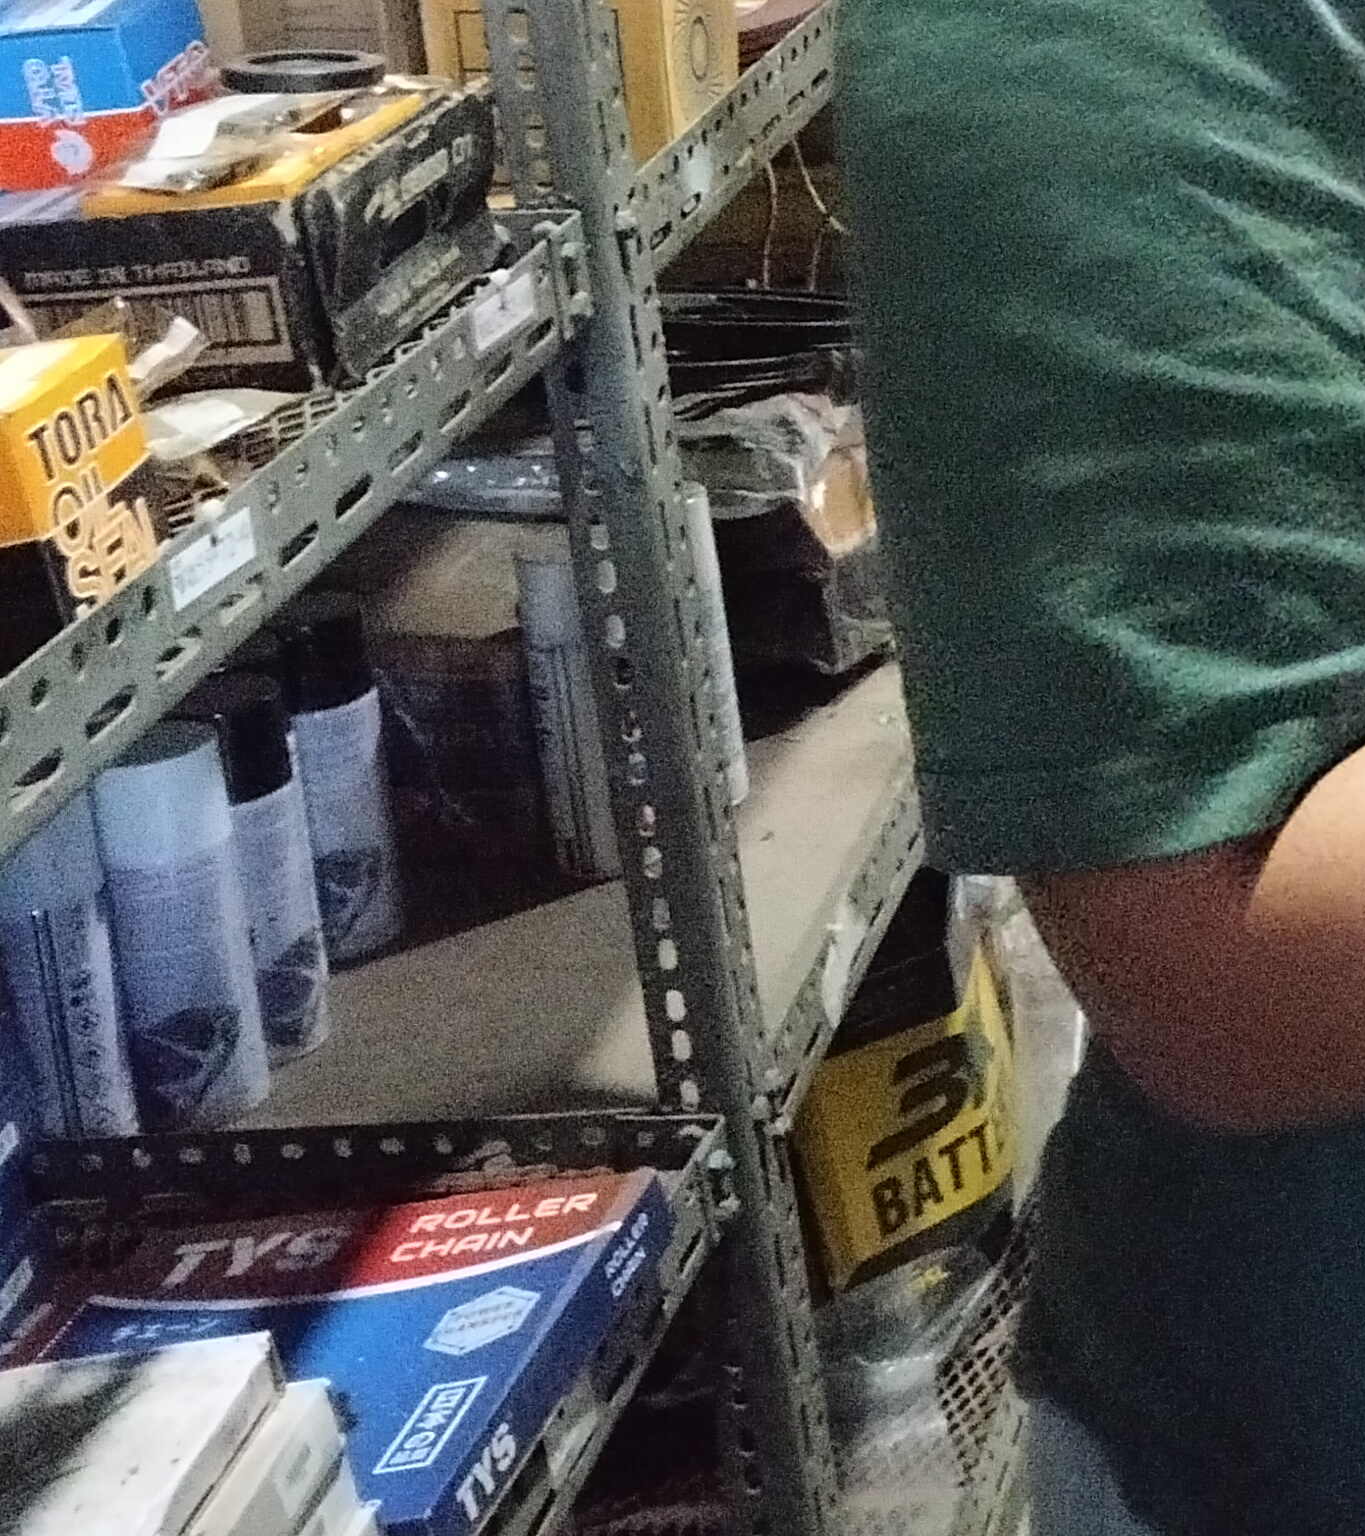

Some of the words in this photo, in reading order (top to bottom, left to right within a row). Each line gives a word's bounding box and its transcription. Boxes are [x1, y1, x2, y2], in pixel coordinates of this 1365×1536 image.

[25, 370, 136, 484] TORA
[409, 1193, 598, 1233] ROLLER
[872, 1121, 1000, 1236] BATT
[162, 1226, 353, 1289] TYS
[390, 1227, 534, 1262] CHAIN
[455, 1421, 517, 1522] TYS
